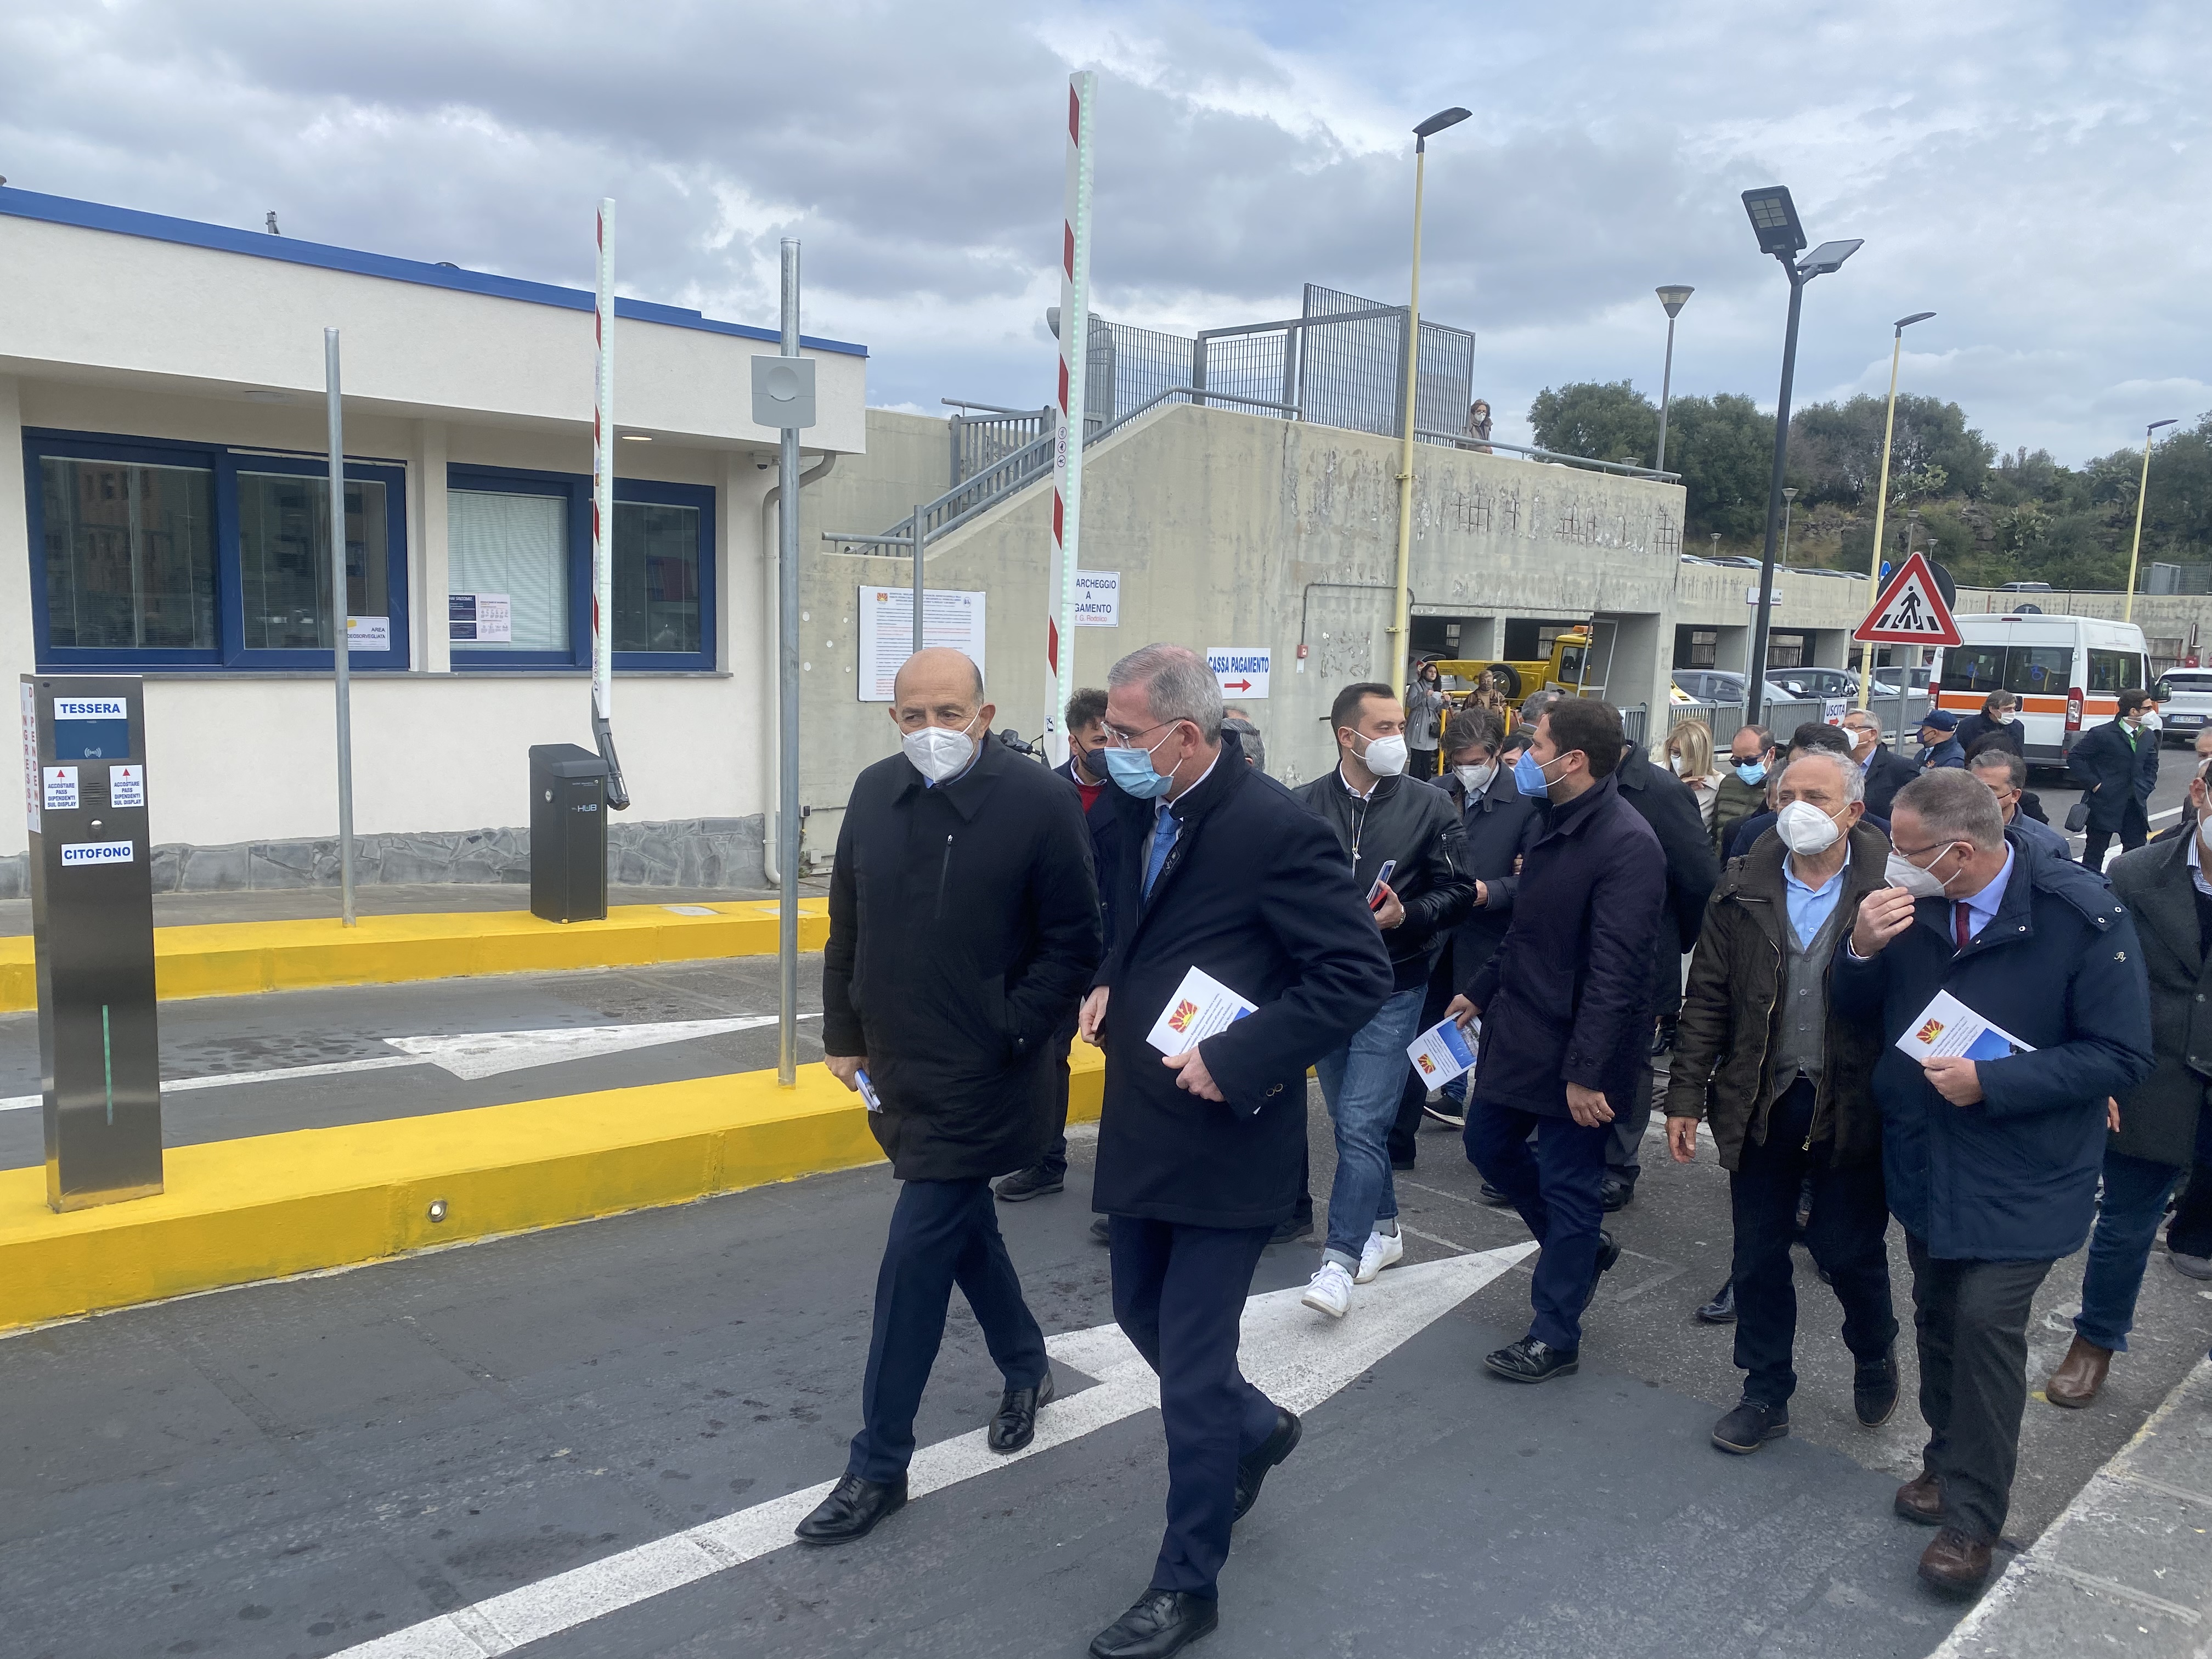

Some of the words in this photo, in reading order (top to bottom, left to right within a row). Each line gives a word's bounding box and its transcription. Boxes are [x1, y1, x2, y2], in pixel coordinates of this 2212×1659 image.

[1076, 579, 1116, 589] ARCHEGGIO
[1086, 591, 1091, 599] A
[1075, 603, 1111, 613] GAMENTO
[1208, 656, 1229, 673] CASSA
[1231, 657, 1269, 673] PAGAMENTO
[60, 703, 120, 713] TESSERA
[1826, 704, 1845, 716] USCITA
[577, 804, 597, 812] HUB
[64, 847, 131, 860] CITOFONO
